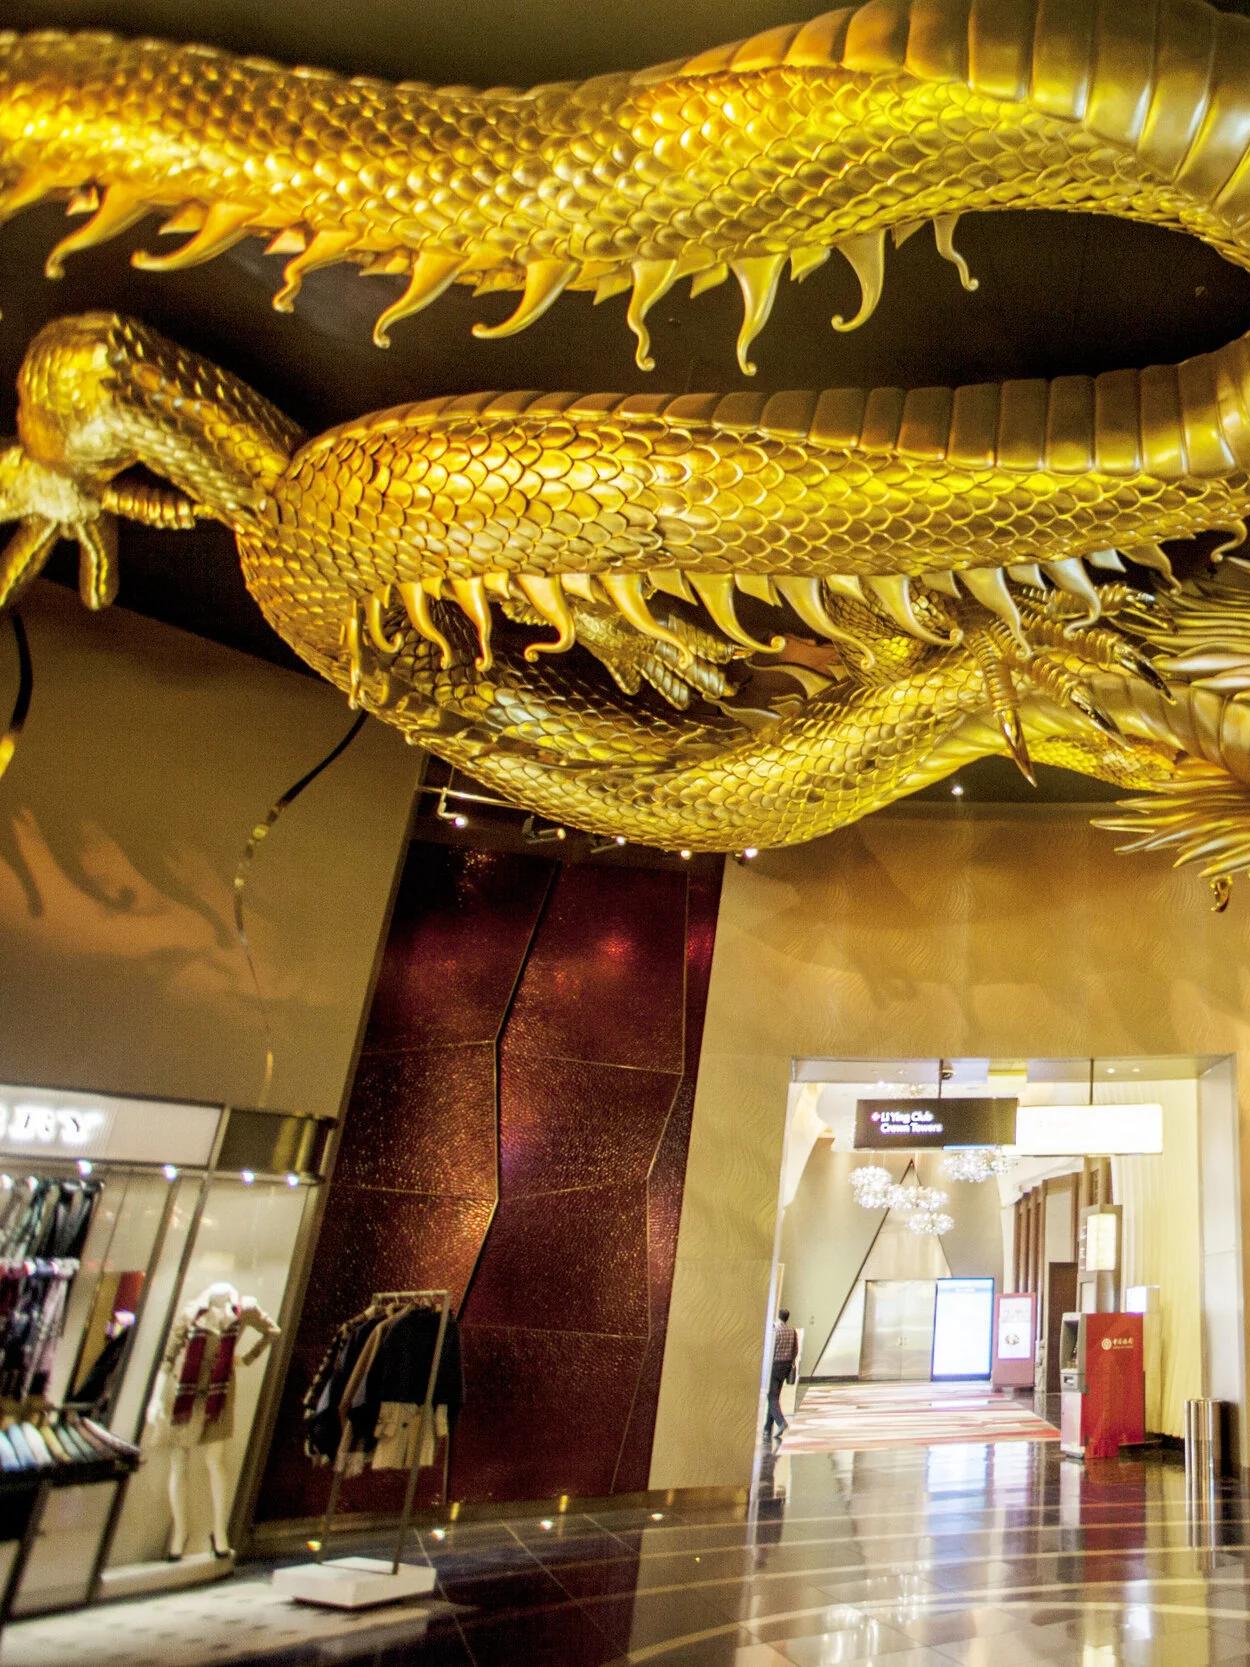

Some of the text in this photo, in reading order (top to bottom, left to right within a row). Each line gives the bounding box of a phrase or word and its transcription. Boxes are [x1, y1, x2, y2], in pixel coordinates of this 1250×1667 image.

[911, 1110, 934, 1122] Club
[880, 1122, 943, 1133] Crown Towers
